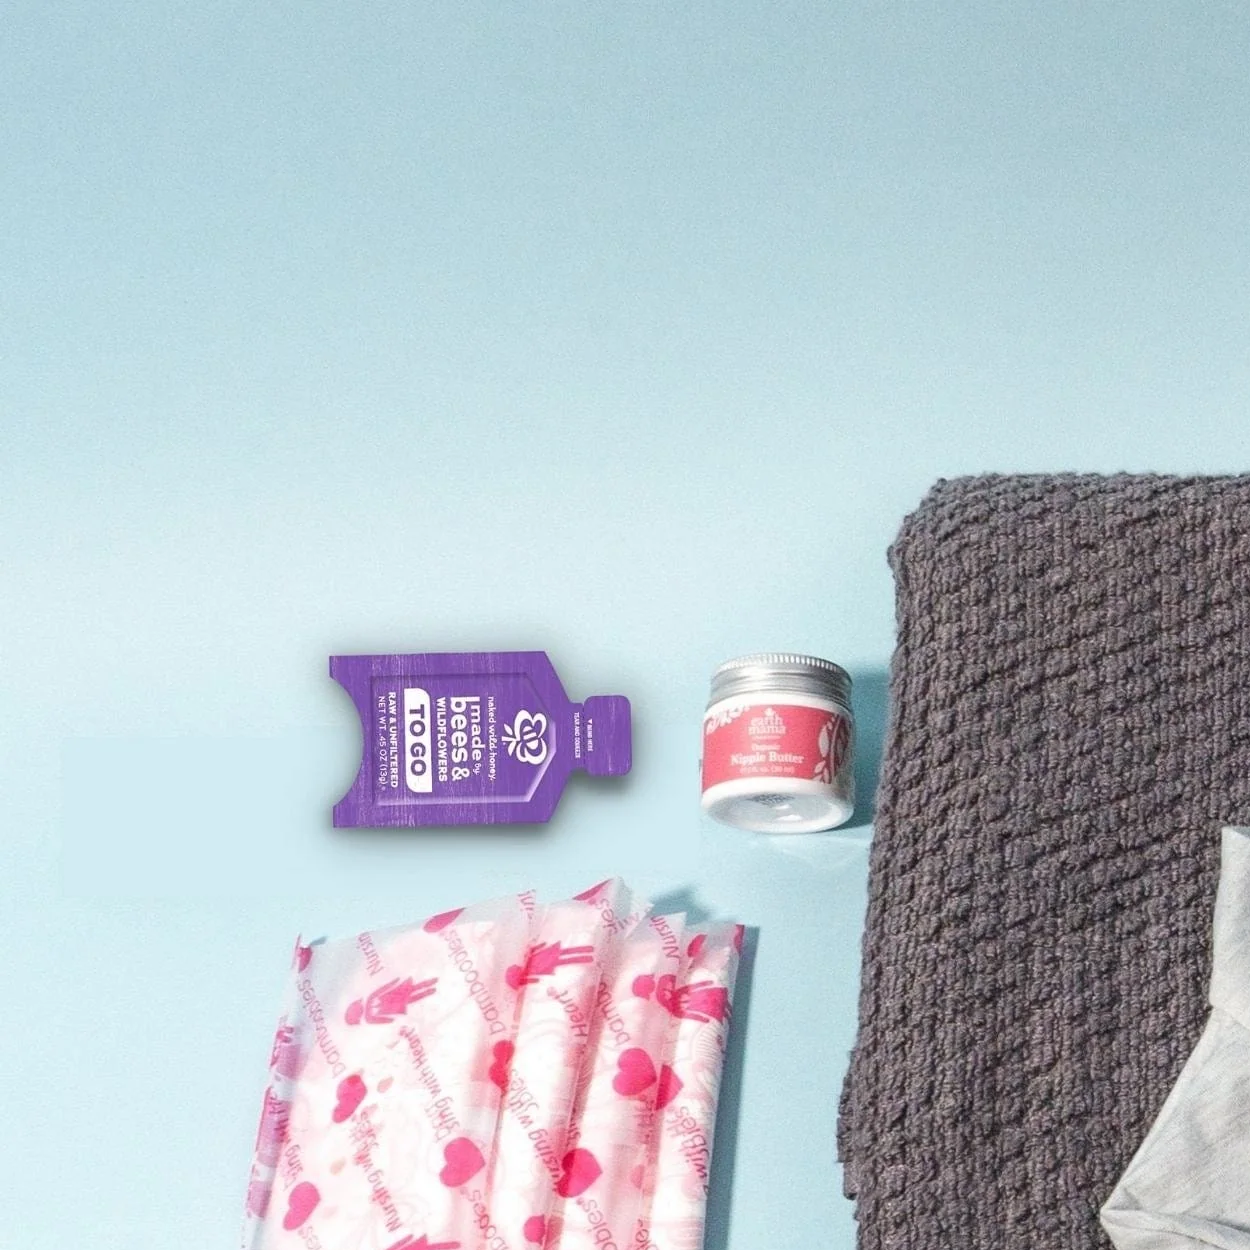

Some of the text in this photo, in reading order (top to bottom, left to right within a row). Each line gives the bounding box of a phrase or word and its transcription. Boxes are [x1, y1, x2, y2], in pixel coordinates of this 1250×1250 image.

[378, 696, 387, 713] NET
[388, 692, 398, 716] RAW
[488, 697, 496, 723] naked
[750, 714, 783, 726] earth
[409, 704, 427, 776] TO GO
[436, 697, 448, 782] WILDFLOWERS
[450, 696, 480, 781] bees &
[471, 705, 486, 761] made
[488, 725, 498, 752] wild
[748, 725, 786, 735] mama
[379, 749, 387, 761] OZ
[379, 764, 389, 784] (13g)
[389, 726, 399, 788] UNFILTERED
[730, 751, 804, 766] Nipple Butter
[359, 933, 383, 977] Nursin
[649, 914, 680, 964] Nursin
[441, 929, 505, 1035] bamboobies
[554, 990, 592, 1040] Heart
[365, 1170, 404, 1233] Nursing
